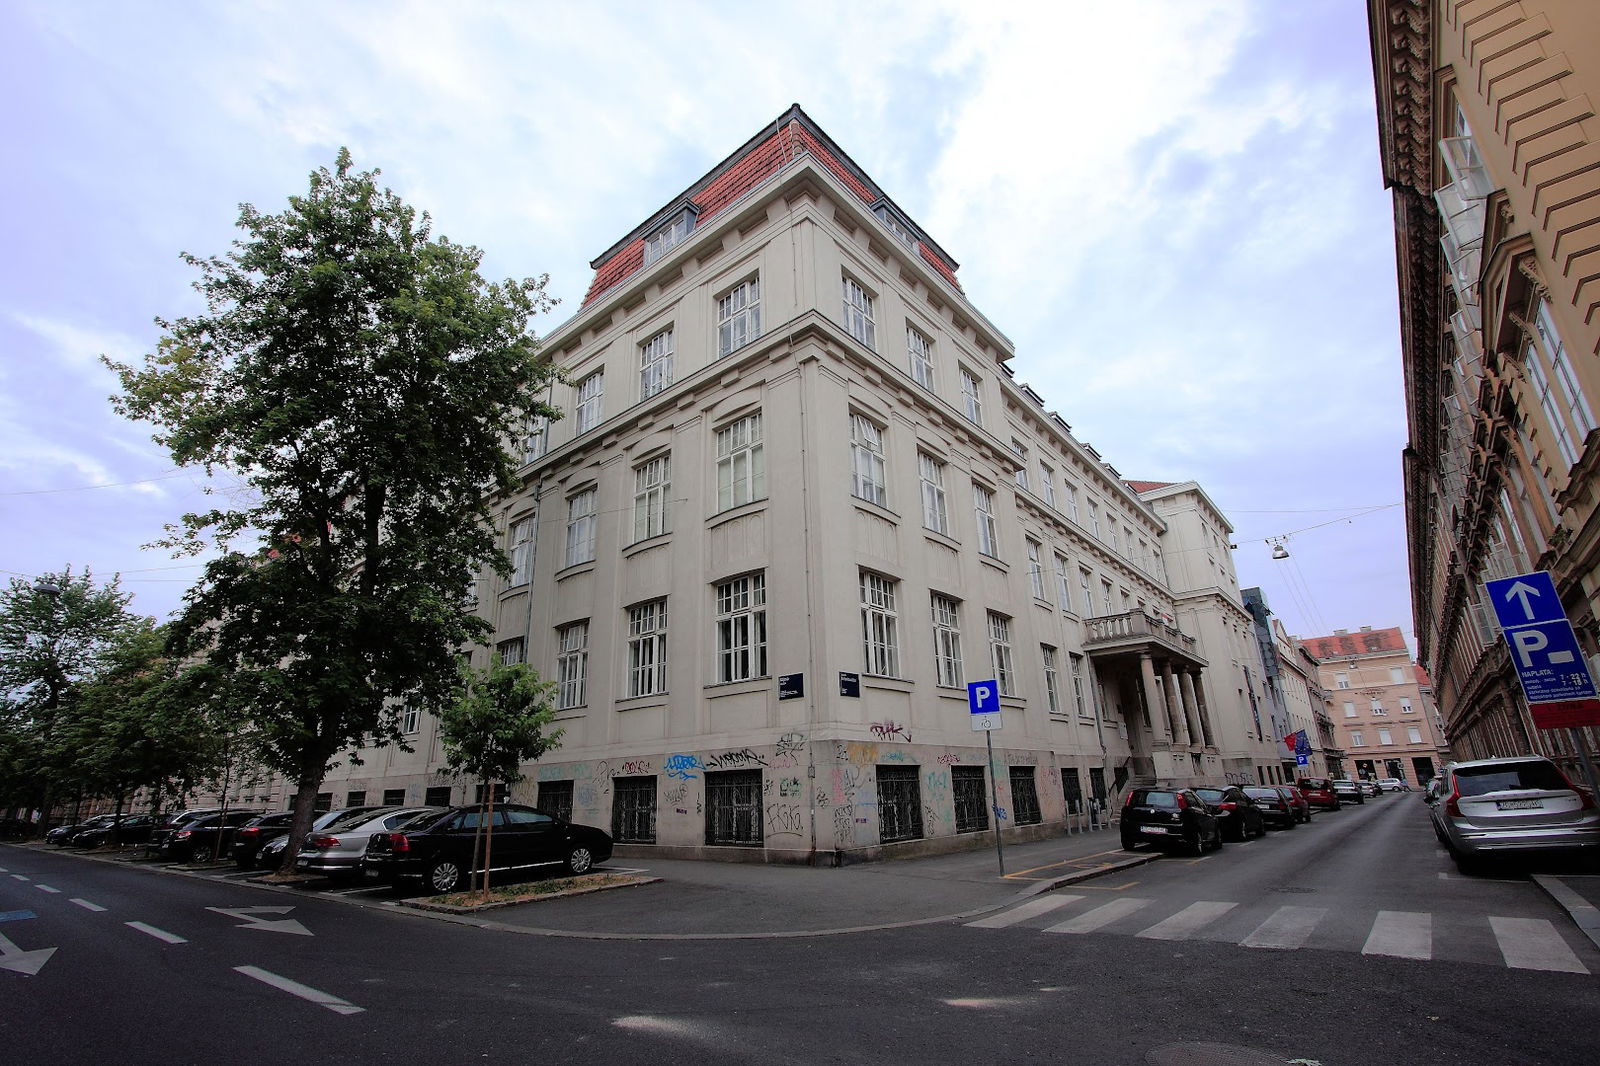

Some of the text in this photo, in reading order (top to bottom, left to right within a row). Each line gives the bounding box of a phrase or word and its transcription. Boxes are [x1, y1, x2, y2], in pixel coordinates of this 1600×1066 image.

[1512, 630, 1548, 667] P
[1521, 669, 1554, 677] NAPLATA:
[976, 687, 990, 708] P
